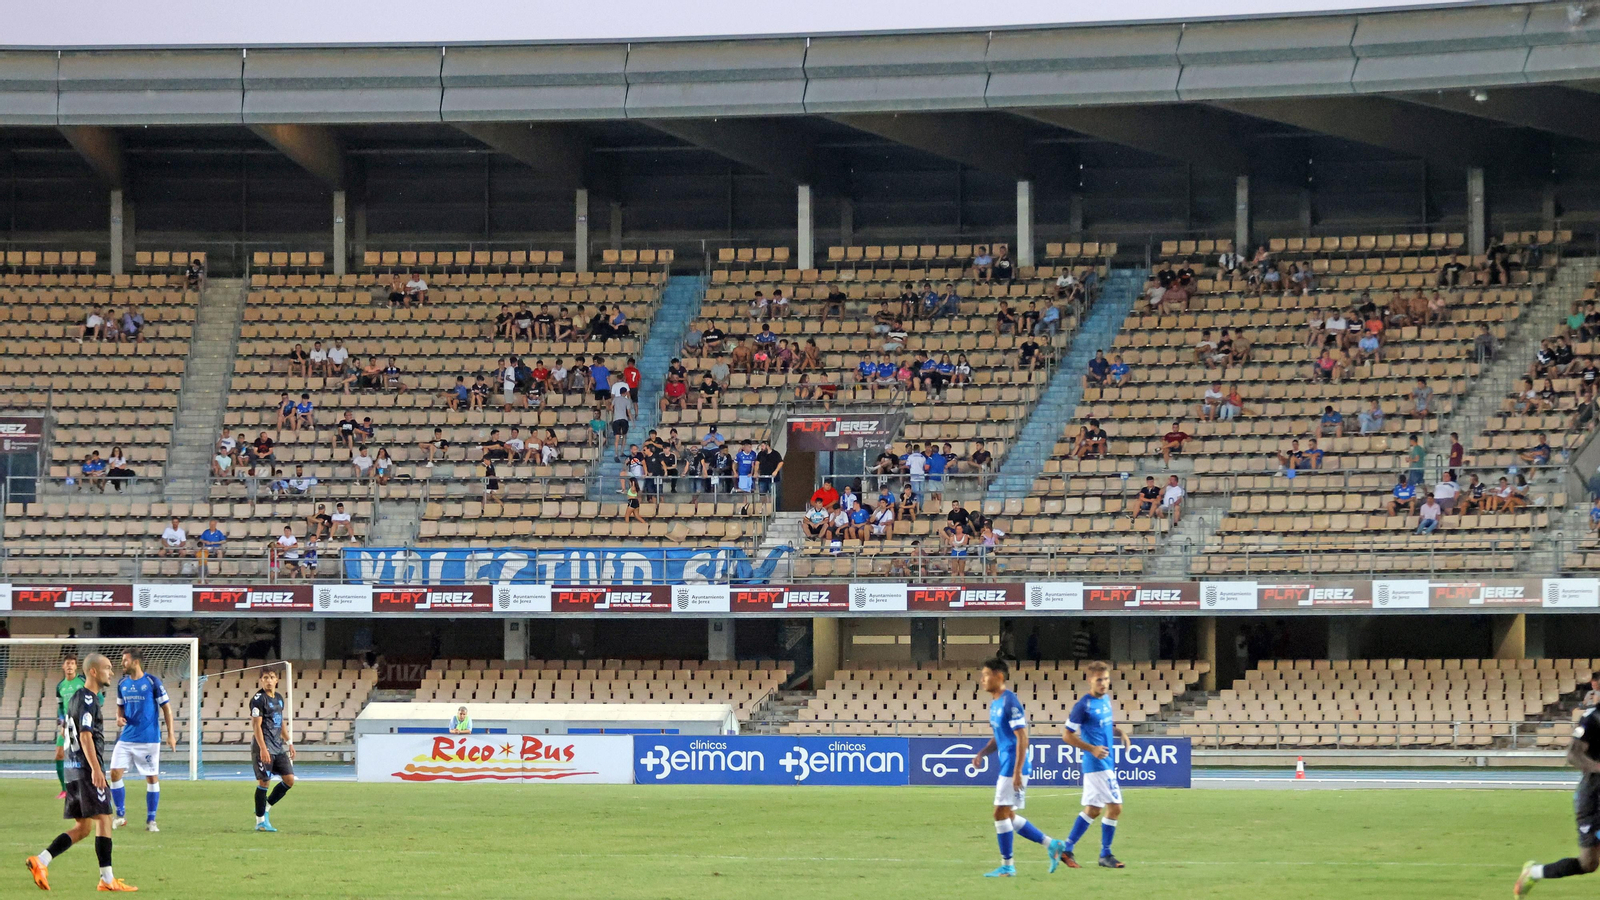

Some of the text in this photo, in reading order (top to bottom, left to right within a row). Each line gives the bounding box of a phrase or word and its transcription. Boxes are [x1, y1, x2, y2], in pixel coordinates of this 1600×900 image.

[631, 371, 637, 382] 7
[792, 421, 832, 432] PLAY
[18, 591, 63, 602] PLAY
[199, 592, 243, 603] PLAY
[379, 593, 423, 604] PLAY
[558, 592, 602, 604] PLAY
[736, 592, 780, 603] PLAY
[914, 590, 957, 602] PLAY
[1090, 589, 1132, 601] PLAY
[1264, 589, 1305, 600] PLAY
[1436, 587, 1477, 599] PLAY
[431, 735, 575, 762] Rico Bus
[690, 740, 727, 750] clínicas
[828, 741, 866, 751] clínicas
[1057, 744, 1178, 764] RETCAR
[1062, 766, 1080, 781] de
